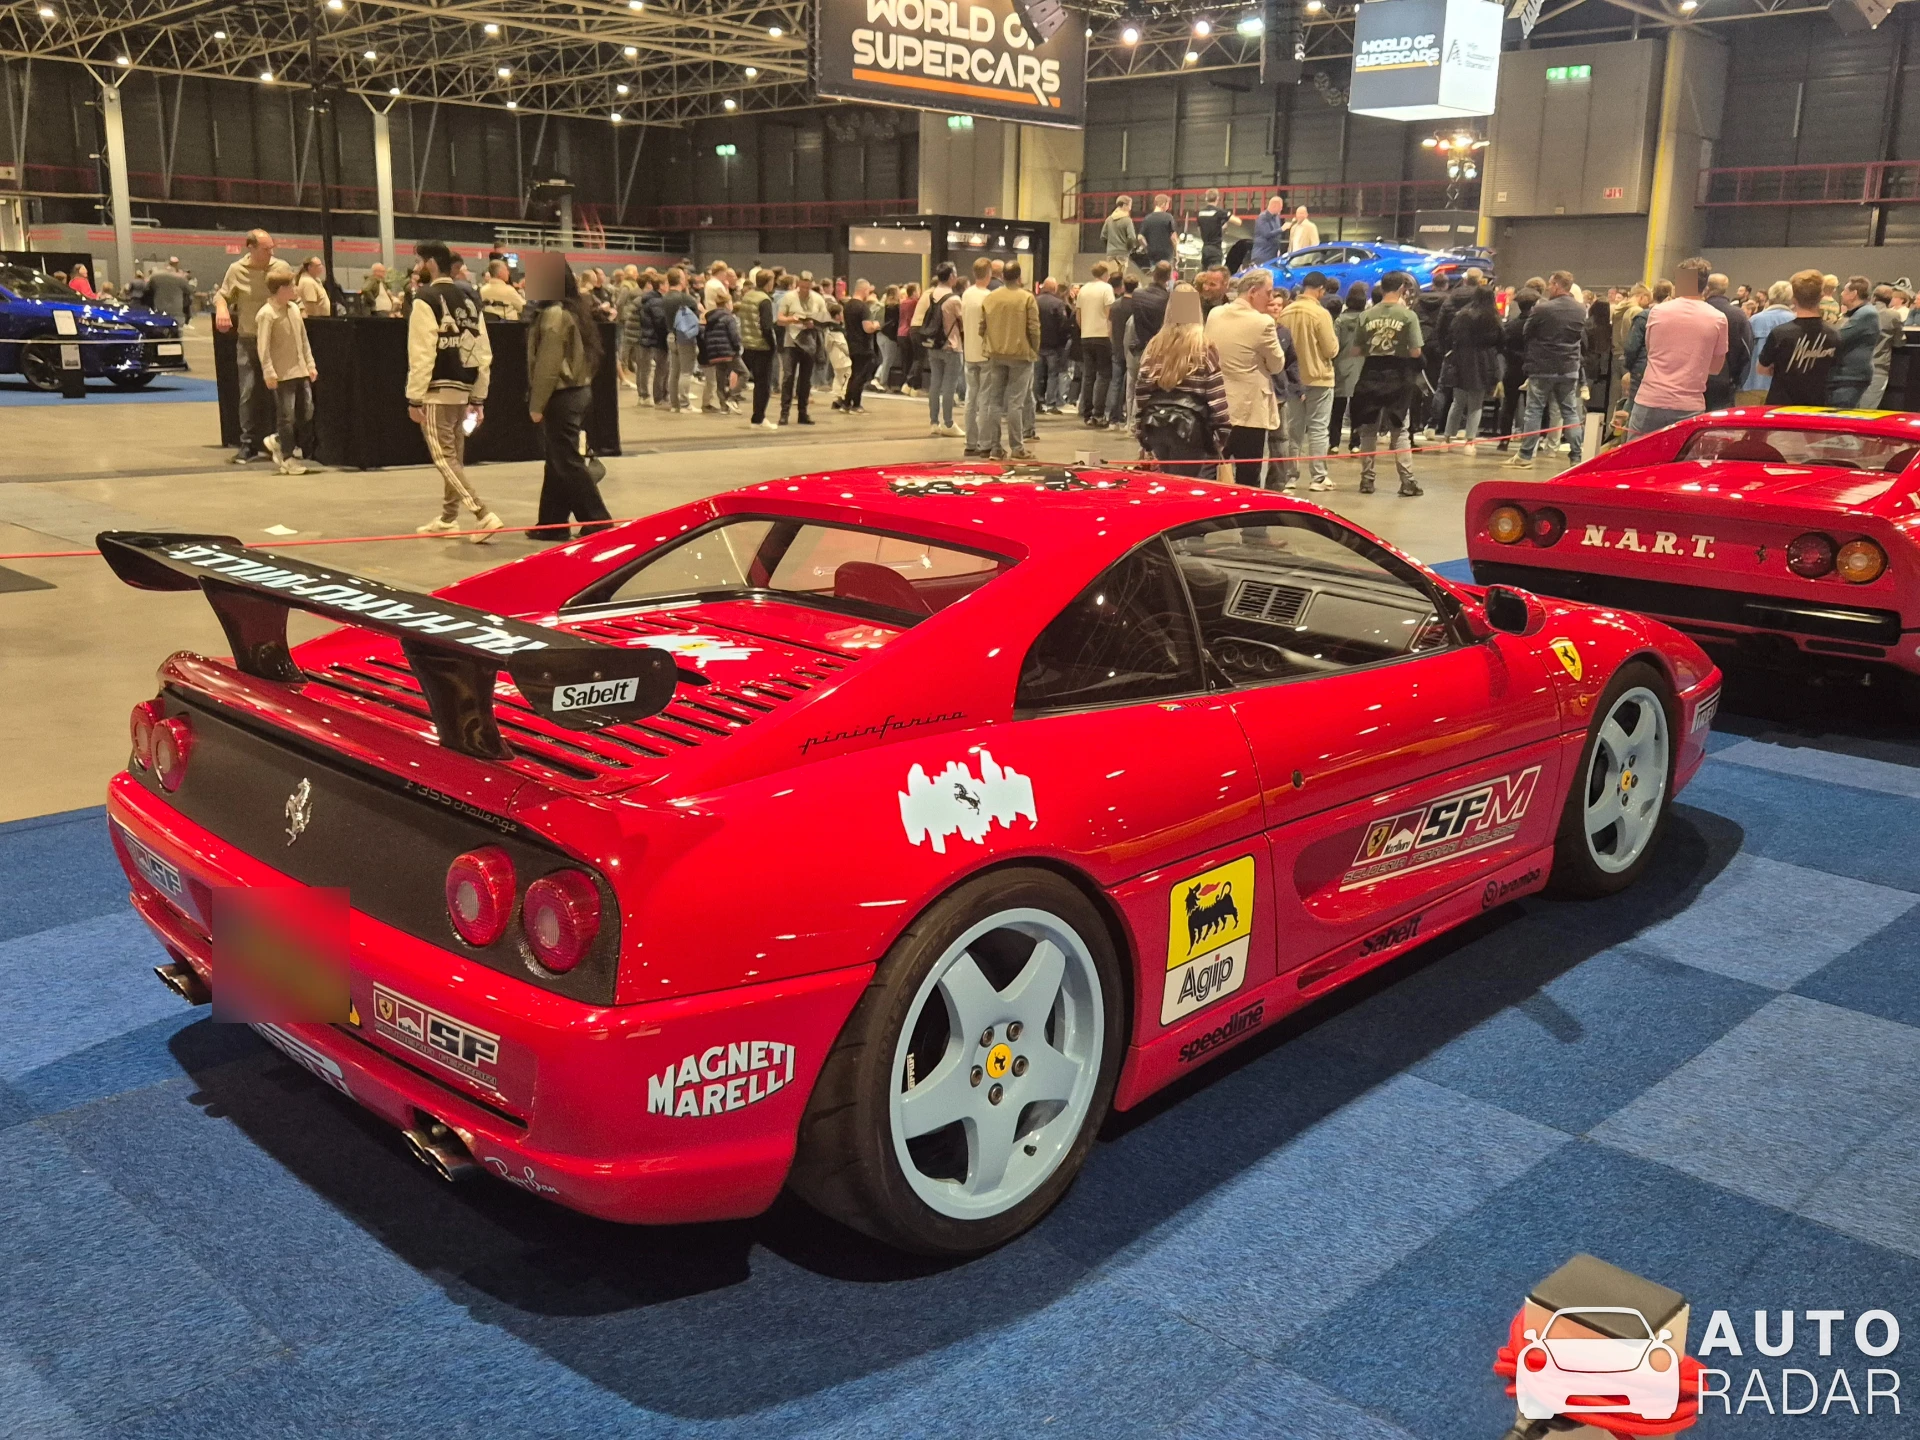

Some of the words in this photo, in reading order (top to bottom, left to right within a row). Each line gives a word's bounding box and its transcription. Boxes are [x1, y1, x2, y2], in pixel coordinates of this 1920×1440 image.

[866, 0, 996, 43] WORLD
[1361, 36, 1413, 54] WORLD
[1413, 33, 1436, 49] OF
[851, 28, 1061, 107] SUPERCARS
[1355, 47, 1440, 67] SUPERCARS
[561, 681, 629, 708] Sabelt
[798, 711, 968, 755] pininfarina
[1414, 765, 1542, 850] SFM
[1341, 855, 1408, 885] SCUDERIA
[1408, 840, 1460, 867] FERRARI
[1385, 839, 1412, 855] Marlboro
[1498, 867, 1542, 898] brembo
[1359, 914, 1422, 957] Sabelt
[1177, 953, 1234, 1005] Agip
[397, 1021, 422, 1039] Marlboro
[427, 1013, 499, 1067] SF
[1178, 998, 1265, 1063] speedline
[647, 1040, 796, 1106] MAGNETI
[647, 1056, 796, 1117] MARELLI
